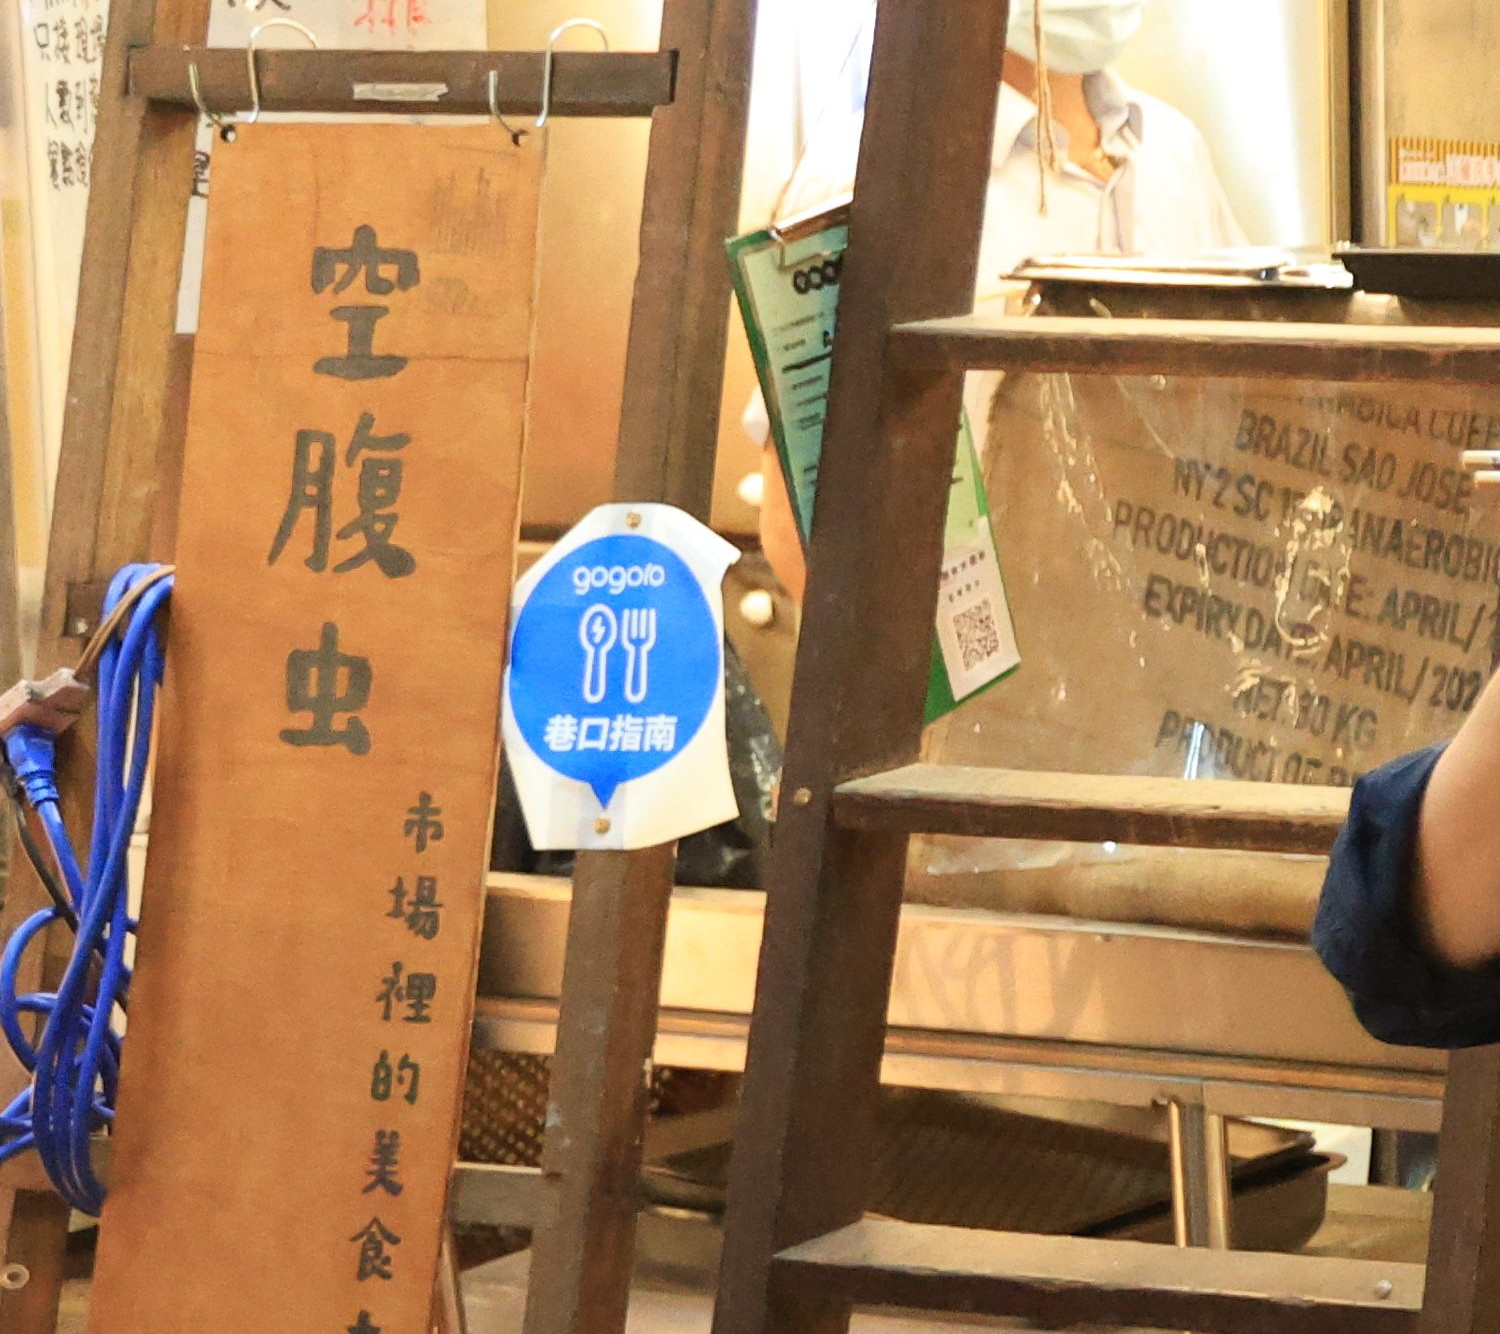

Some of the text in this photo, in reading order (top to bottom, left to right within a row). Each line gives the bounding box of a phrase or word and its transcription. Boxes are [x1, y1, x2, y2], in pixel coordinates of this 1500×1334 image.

[267, 223, 421, 757] 空腹虫
[1236, 409, 1330, 476] BRAZIL
[1342, 442, 1397, 490] SAO
[1399, 461, 1475, 515] JOSE
[572, 562, 666, 596] gogoro
[543, 713, 679, 753] 巷口指南
